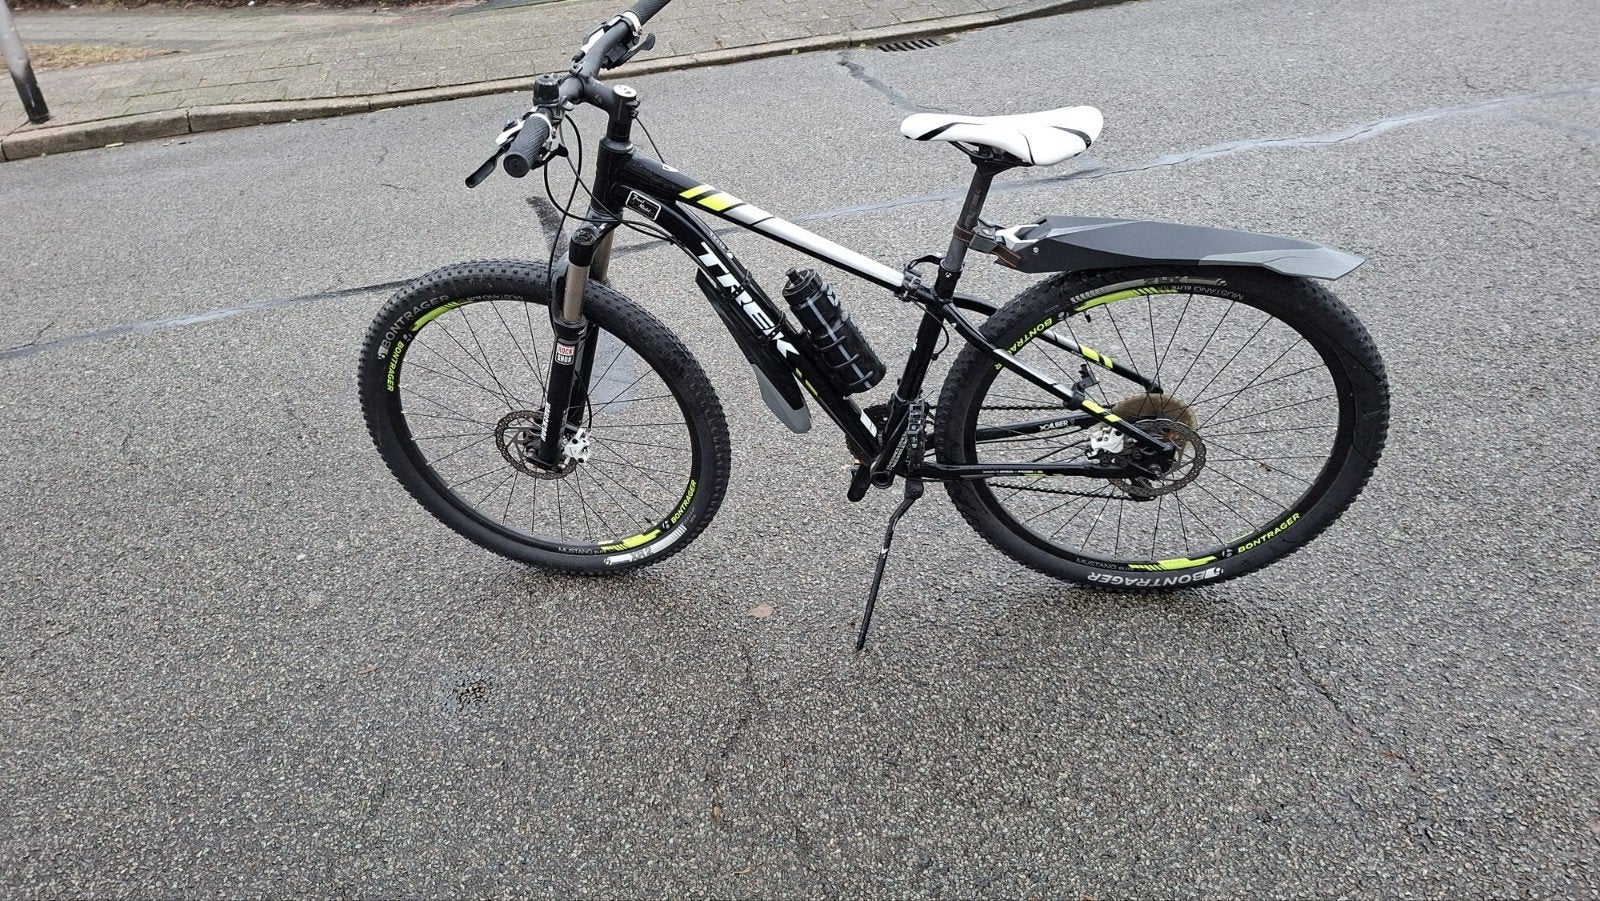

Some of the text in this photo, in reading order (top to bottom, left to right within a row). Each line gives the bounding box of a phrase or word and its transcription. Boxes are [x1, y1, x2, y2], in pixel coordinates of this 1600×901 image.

[698, 241, 800, 358] TREK
[1193, 286, 1244, 300] MUSTANG
[382, 295, 450, 349] BONTRAGER
[387, 341, 404, 392] BONTRAGER
[671, 479, 697, 524] BONTRAGER
[1238, 512, 1301, 554] BONTRAGER
[1087, 570, 1205, 587] BONTRAGER
